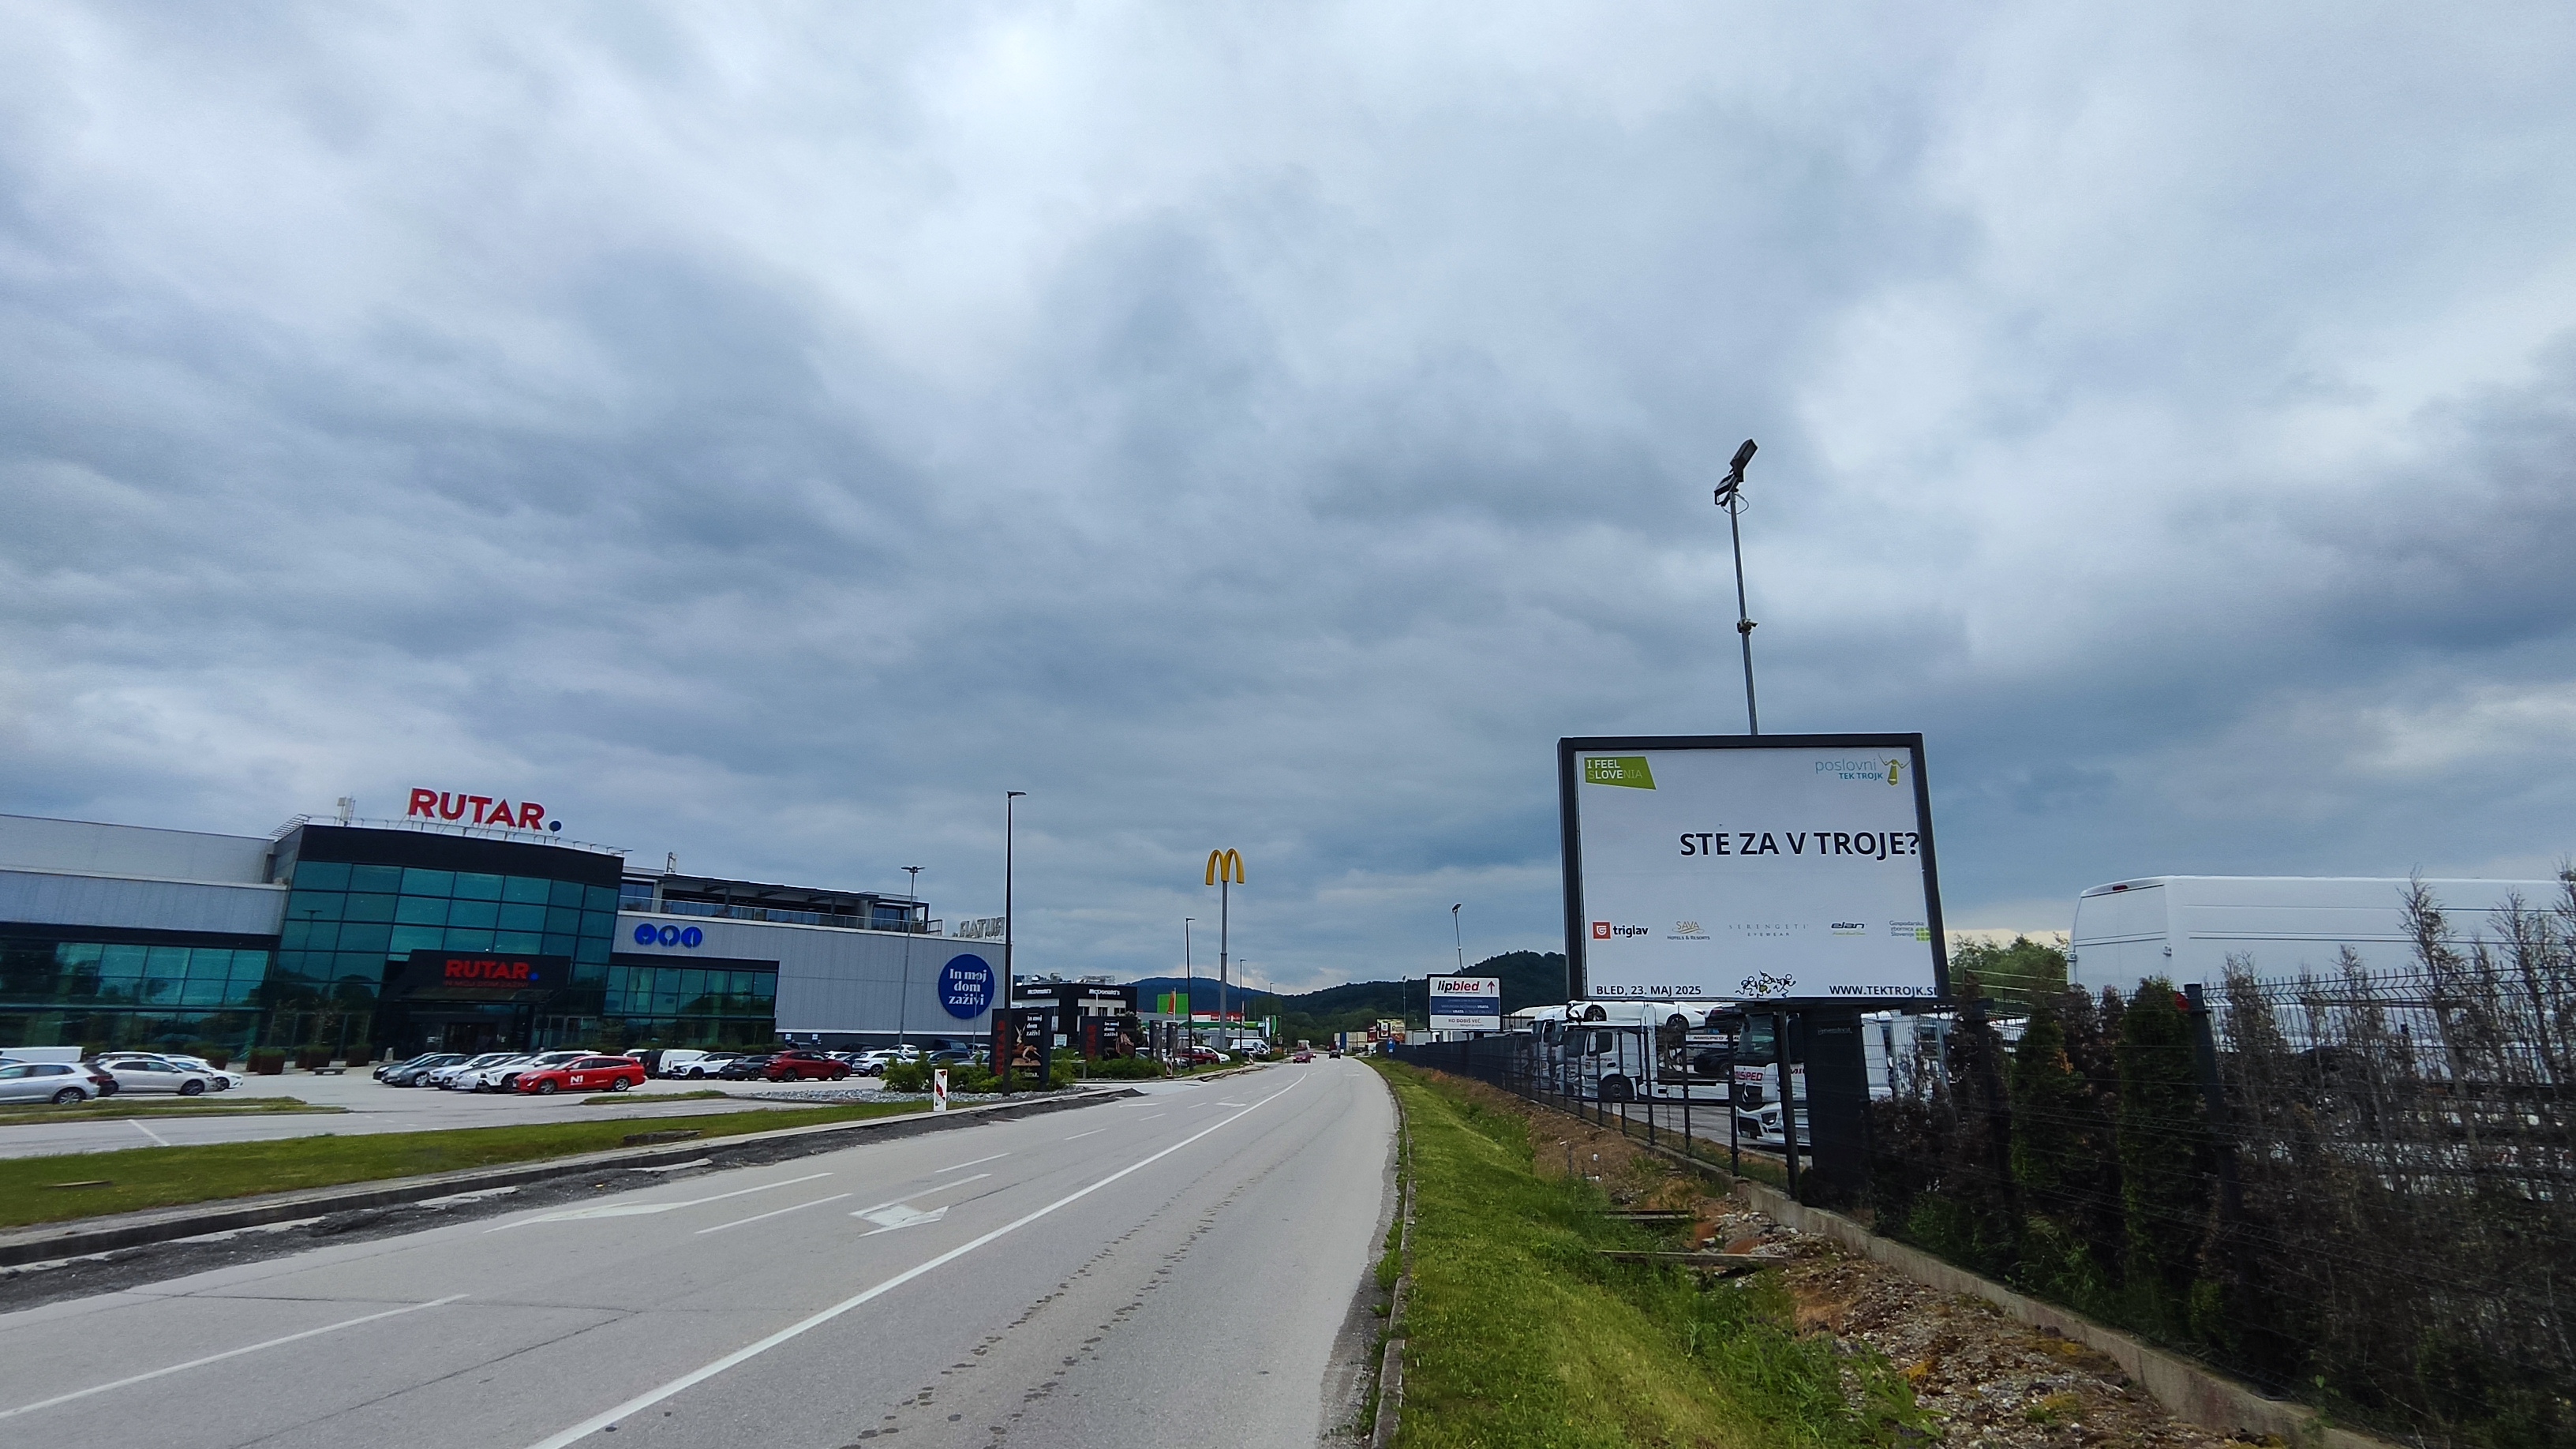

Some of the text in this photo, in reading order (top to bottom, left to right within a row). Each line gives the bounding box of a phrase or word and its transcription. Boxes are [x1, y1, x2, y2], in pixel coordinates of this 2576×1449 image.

[1587, 759, 1620, 769] I FEEL
[1815, 758, 1877, 773] poslovni
[1588, 769, 1642, 780] SLOVENIA
[1679, 832, 1920, 861] STE ZA V TROJE?
[1676, 921, 1699, 930] SAVA
[1613, 925, 1648, 938] triglav
[949, 968, 987, 983] In moj
[953, 981, 980, 992] dom
[1437, 980, 1480, 994] lipbled
[1596, 986, 1702, 997] BLED, 23. MAJ 2025
[1829, 986, 1938, 998] WWW.TEKTROJK.SI
[949, 994, 984, 1005] zaživi
[571, 1075, 583, 1084] N1
